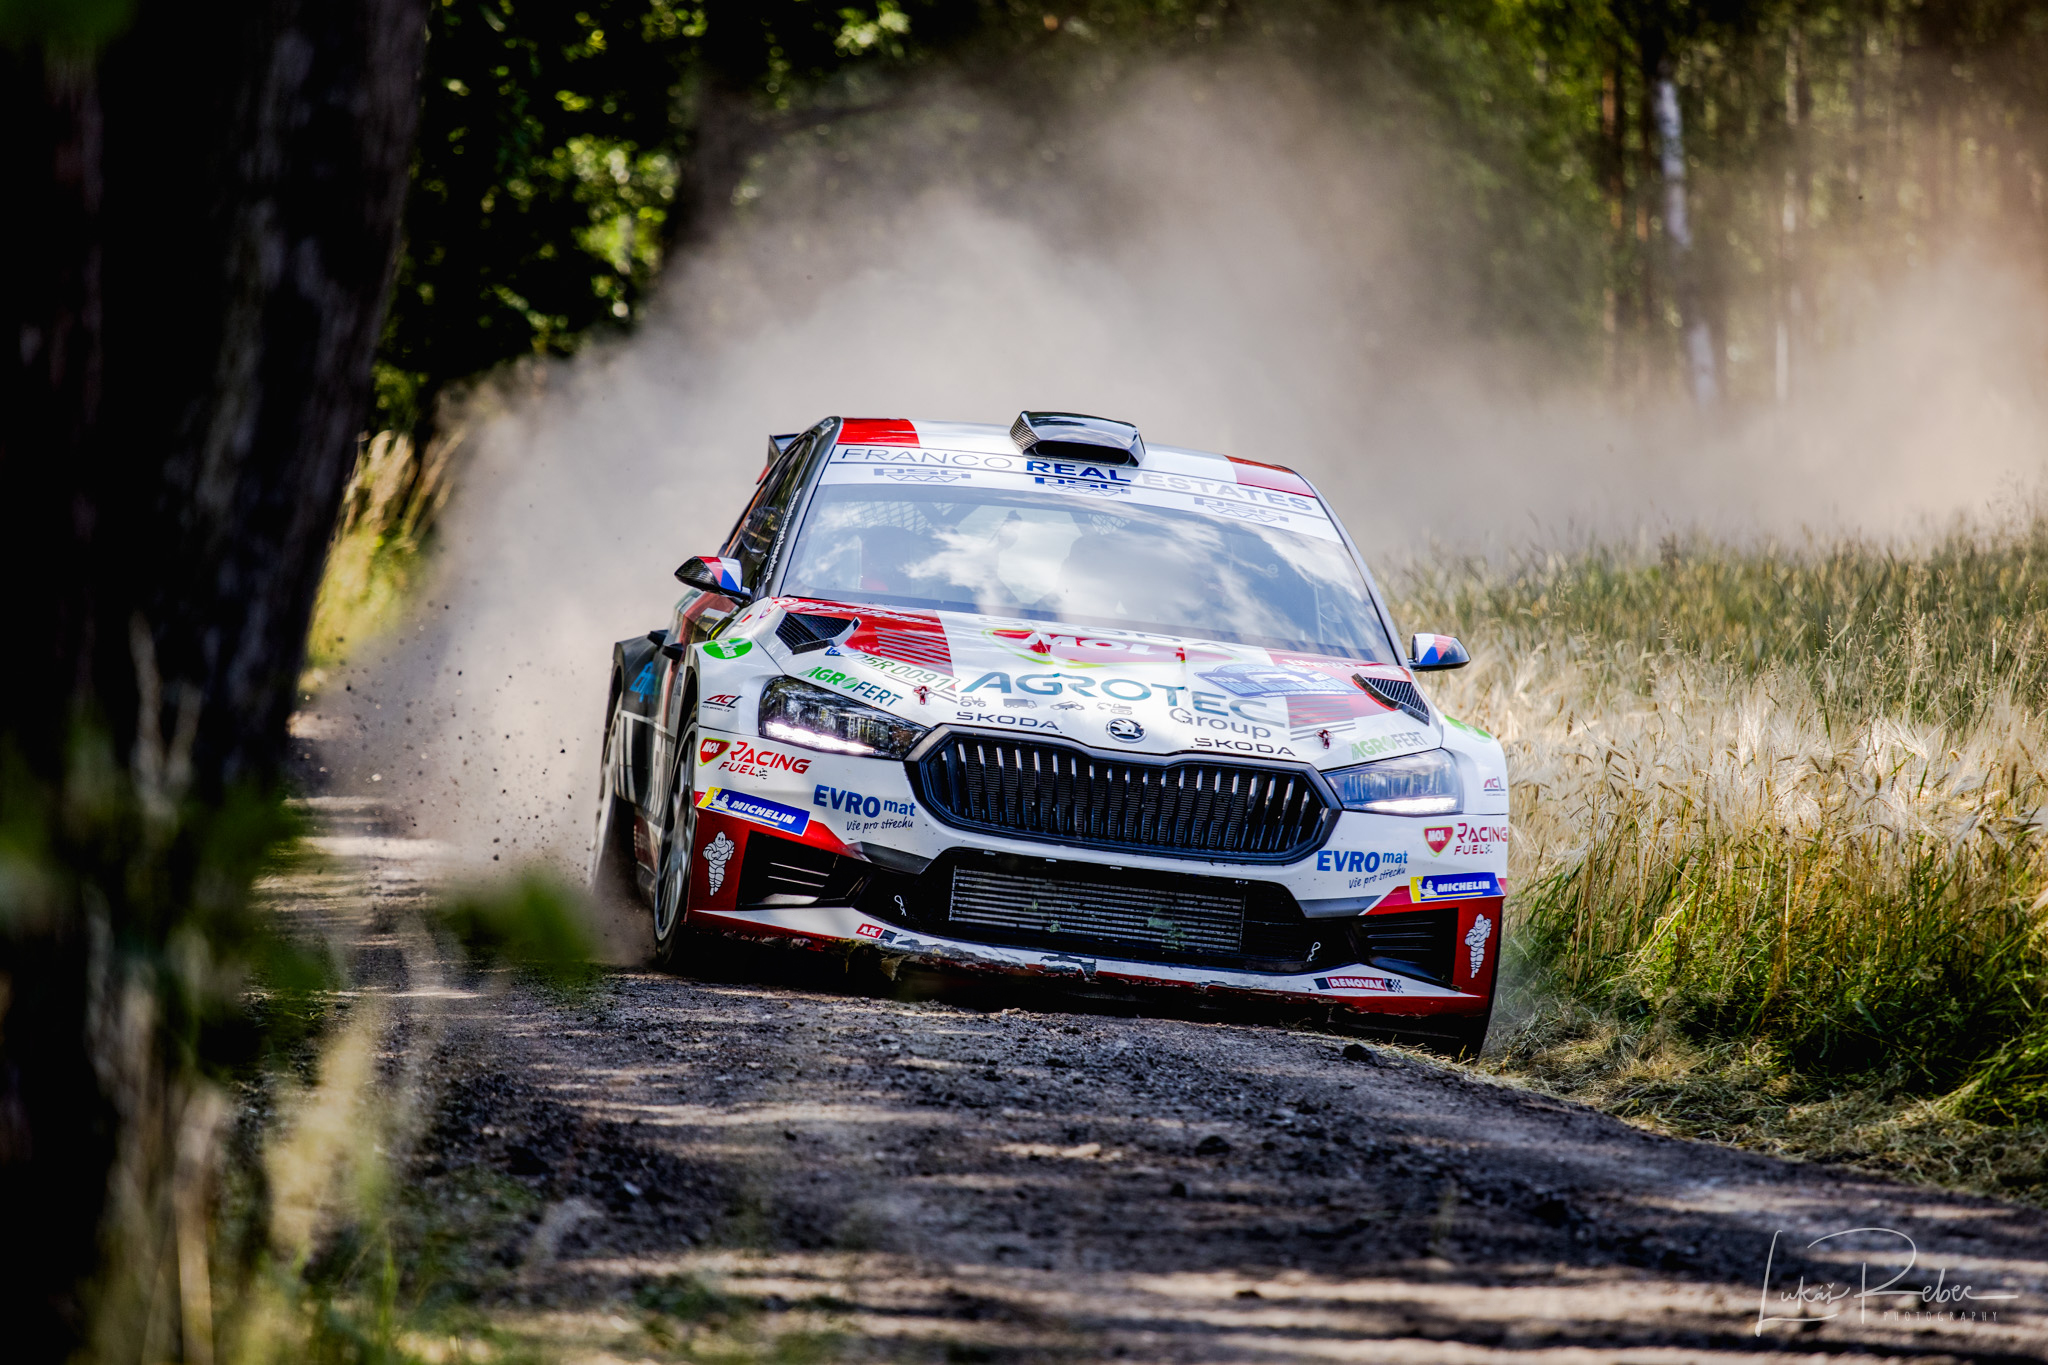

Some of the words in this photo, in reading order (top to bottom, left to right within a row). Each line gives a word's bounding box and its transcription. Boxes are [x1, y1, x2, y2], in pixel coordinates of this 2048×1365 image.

[841, 448, 1012, 470] FRANCO
[1026, 460, 1131, 483] REAL
[1141, 472, 1313, 511] ESTATES
[1021, 632, 1157, 656] MOL
[797, 666, 904, 707] AGROFERT
[890, 665, 953, 690] 0091
[702, 694, 743, 709] ACL
[959, 671, 1286, 729] AGROTEC
[1168, 706, 1272, 742] Group
[701, 741, 720, 754] MOL
[729, 740, 812, 775] RACING
[1351, 731, 1429, 761] AGROFERT
[718, 761, 756, 776] FUEL
[730, 800, 797, 825] MICHELIN
[812, 784, 881, 818] EVRO
[883, 799, 916, 817] mat
[846, 819, 862, 831] Vše
[862, 820, 879, 833] pro
[881, 816, 914, 829] střechu
[1427, 829, 1446, 842] MOL
[1456, 822, 1508, 843] RACING
[1316, 851, 1381, 873] EVRO
[1382, 850, 1408, 865] mat
[1454, 844, 1484, 856] FUEL
[1363, 874, 1377, 889] pro
[1437, 880, 1491, 893] MICHELIN
[1329, 977, 1386, 991] RENOVAK
